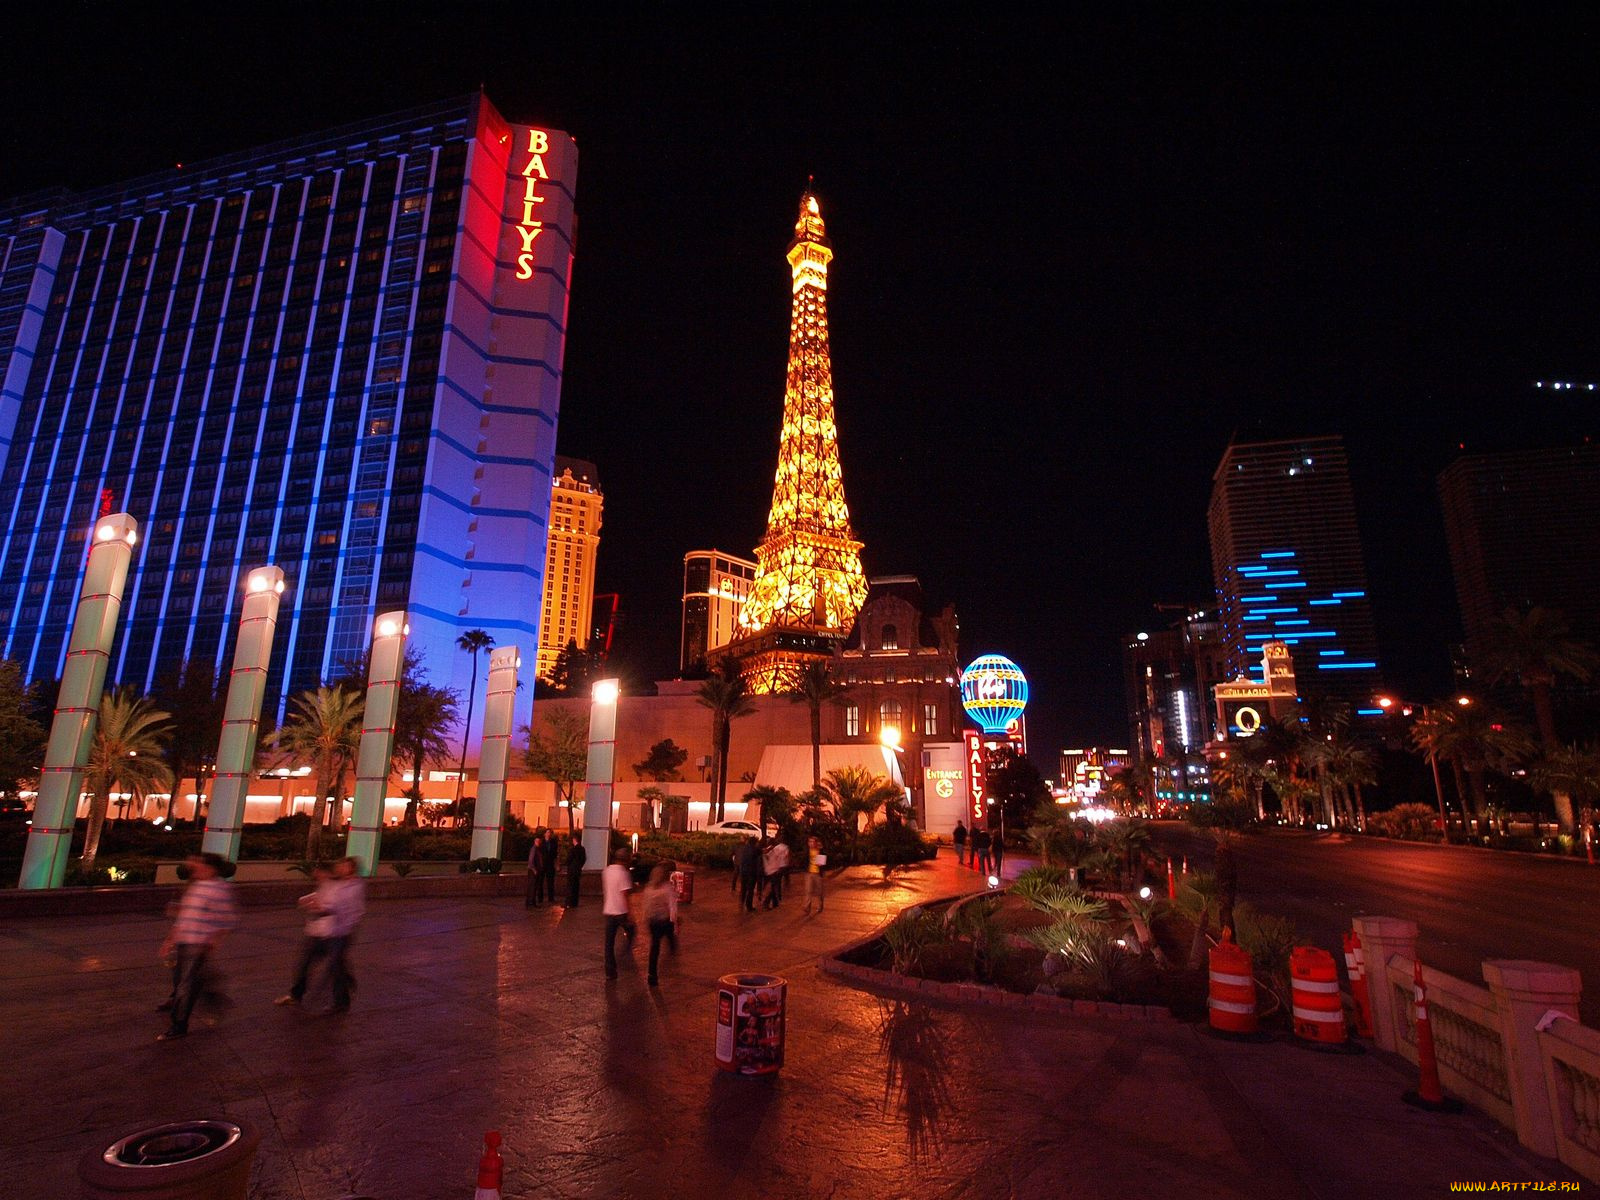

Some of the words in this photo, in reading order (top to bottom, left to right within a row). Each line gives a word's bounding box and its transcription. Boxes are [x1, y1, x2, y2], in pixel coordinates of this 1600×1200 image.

[515, 129, 549, 280] BALLYS
[926, 768, 963, 780] ENTRANCE
[970, 736, 983, 819] BALLYS
